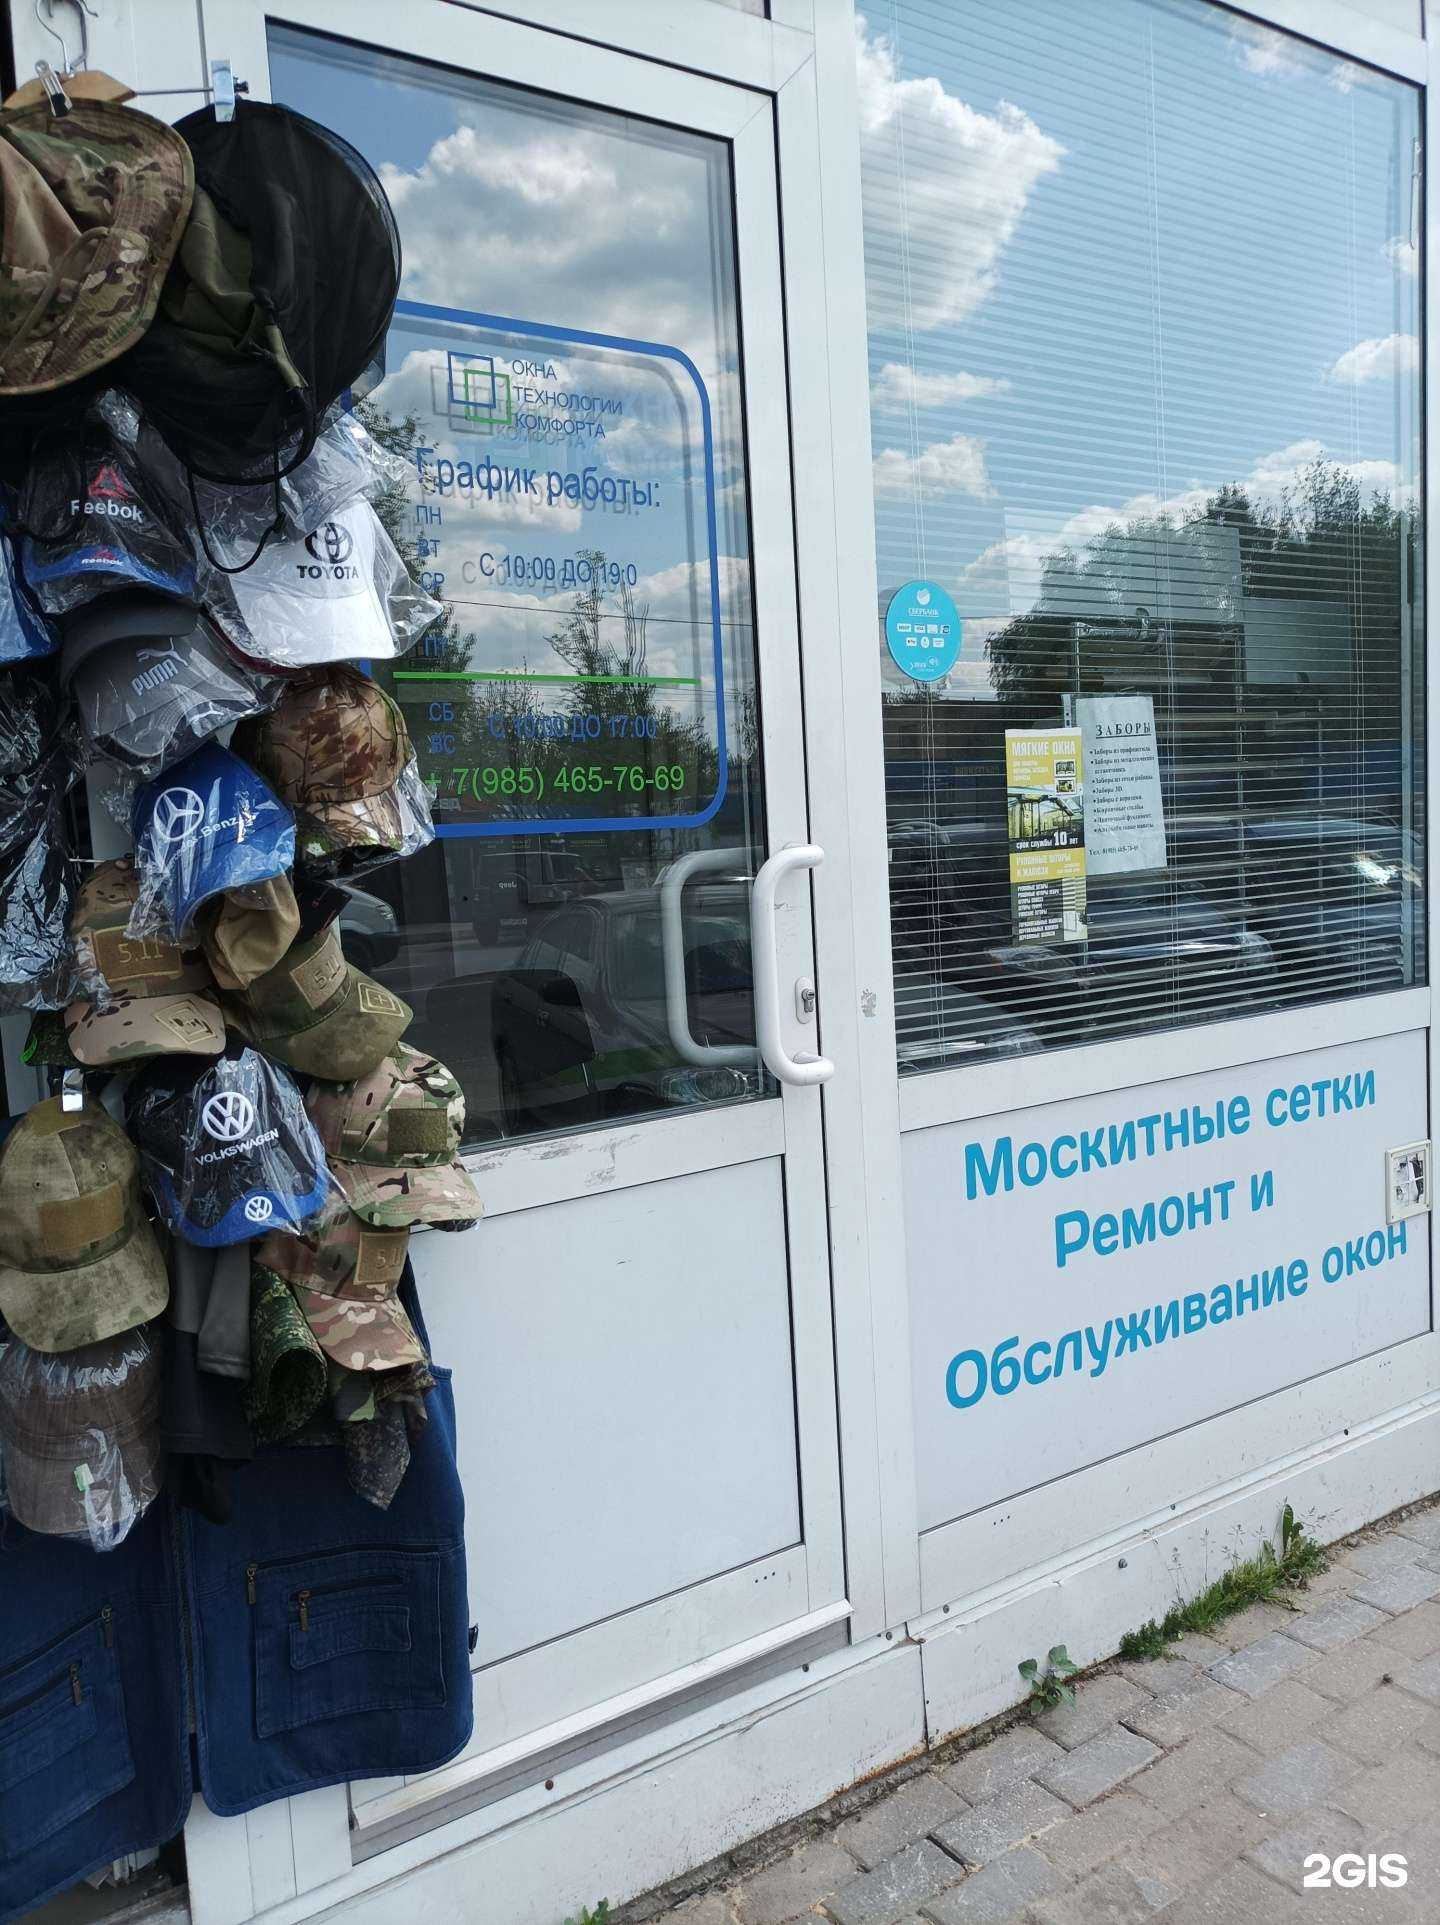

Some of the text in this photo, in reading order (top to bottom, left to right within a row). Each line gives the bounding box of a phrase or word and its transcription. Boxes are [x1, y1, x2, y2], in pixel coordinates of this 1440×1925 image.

[512, 360, 557, 380] ОКНА
[513, 386, 622, 414] ТЕХНОЛОГИИ
[516, 413, 605, 438] КОМФОРТА
[416, 447, 660, 507] График работы:
[416, 505, 442, 525] ПН
[297, 565, 359, 579] TOYOTA
[480, 553, 494, 576] С
[503, 555, 555, 580] 10:00
[562, 559, 592, 586] ДО
[132, 659, 178, 696] PUMA
[429, 702, 454, 721] СБ
[571, 714, 600, 742] ДО
[1096, 722, 1151, 736] ЗАБОРЫ
[431, 735, 456, 753] ВС
[453, 767, 544, 801] 7(985)
[553, 766, 684, 794] 465-76-69
[1054, 831, 1067, 846] 10
[118, 932, 164, 963] 5.11
[195, 1128, 279, 1166] VOLKSWAGEN
[964, 1069, 1376, 1201] Москитные сетки
[1054, 1170, 1275, 1268] Ремонт и
[945, 1221, 1407, 1410] Обслуживание окон
